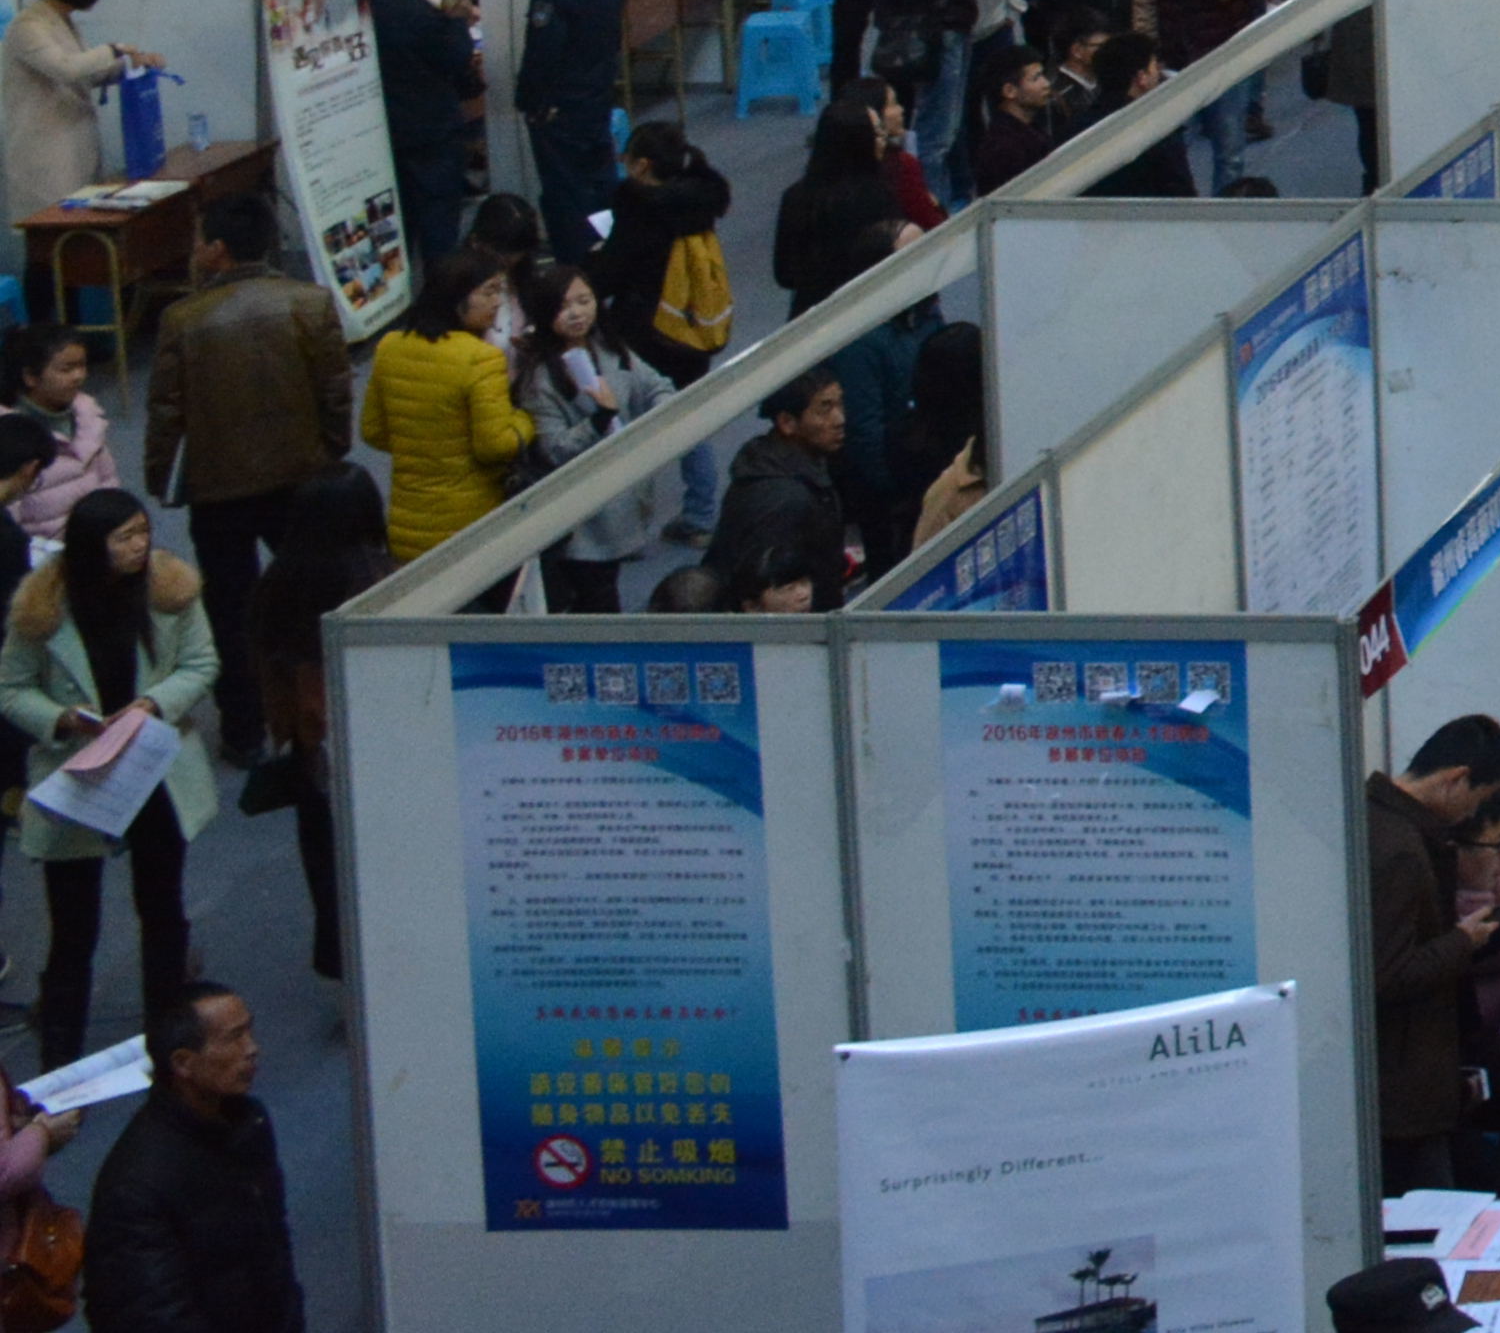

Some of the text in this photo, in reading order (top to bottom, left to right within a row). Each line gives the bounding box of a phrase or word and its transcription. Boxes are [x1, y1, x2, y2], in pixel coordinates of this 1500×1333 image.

[1359, 614, 1391, 676] 044
[600, 1139, 737, 1164] 禁止吸烟
[600, 1168, 631, 1185] NO
[880, 1167, 992, 1194] Surprisingly
